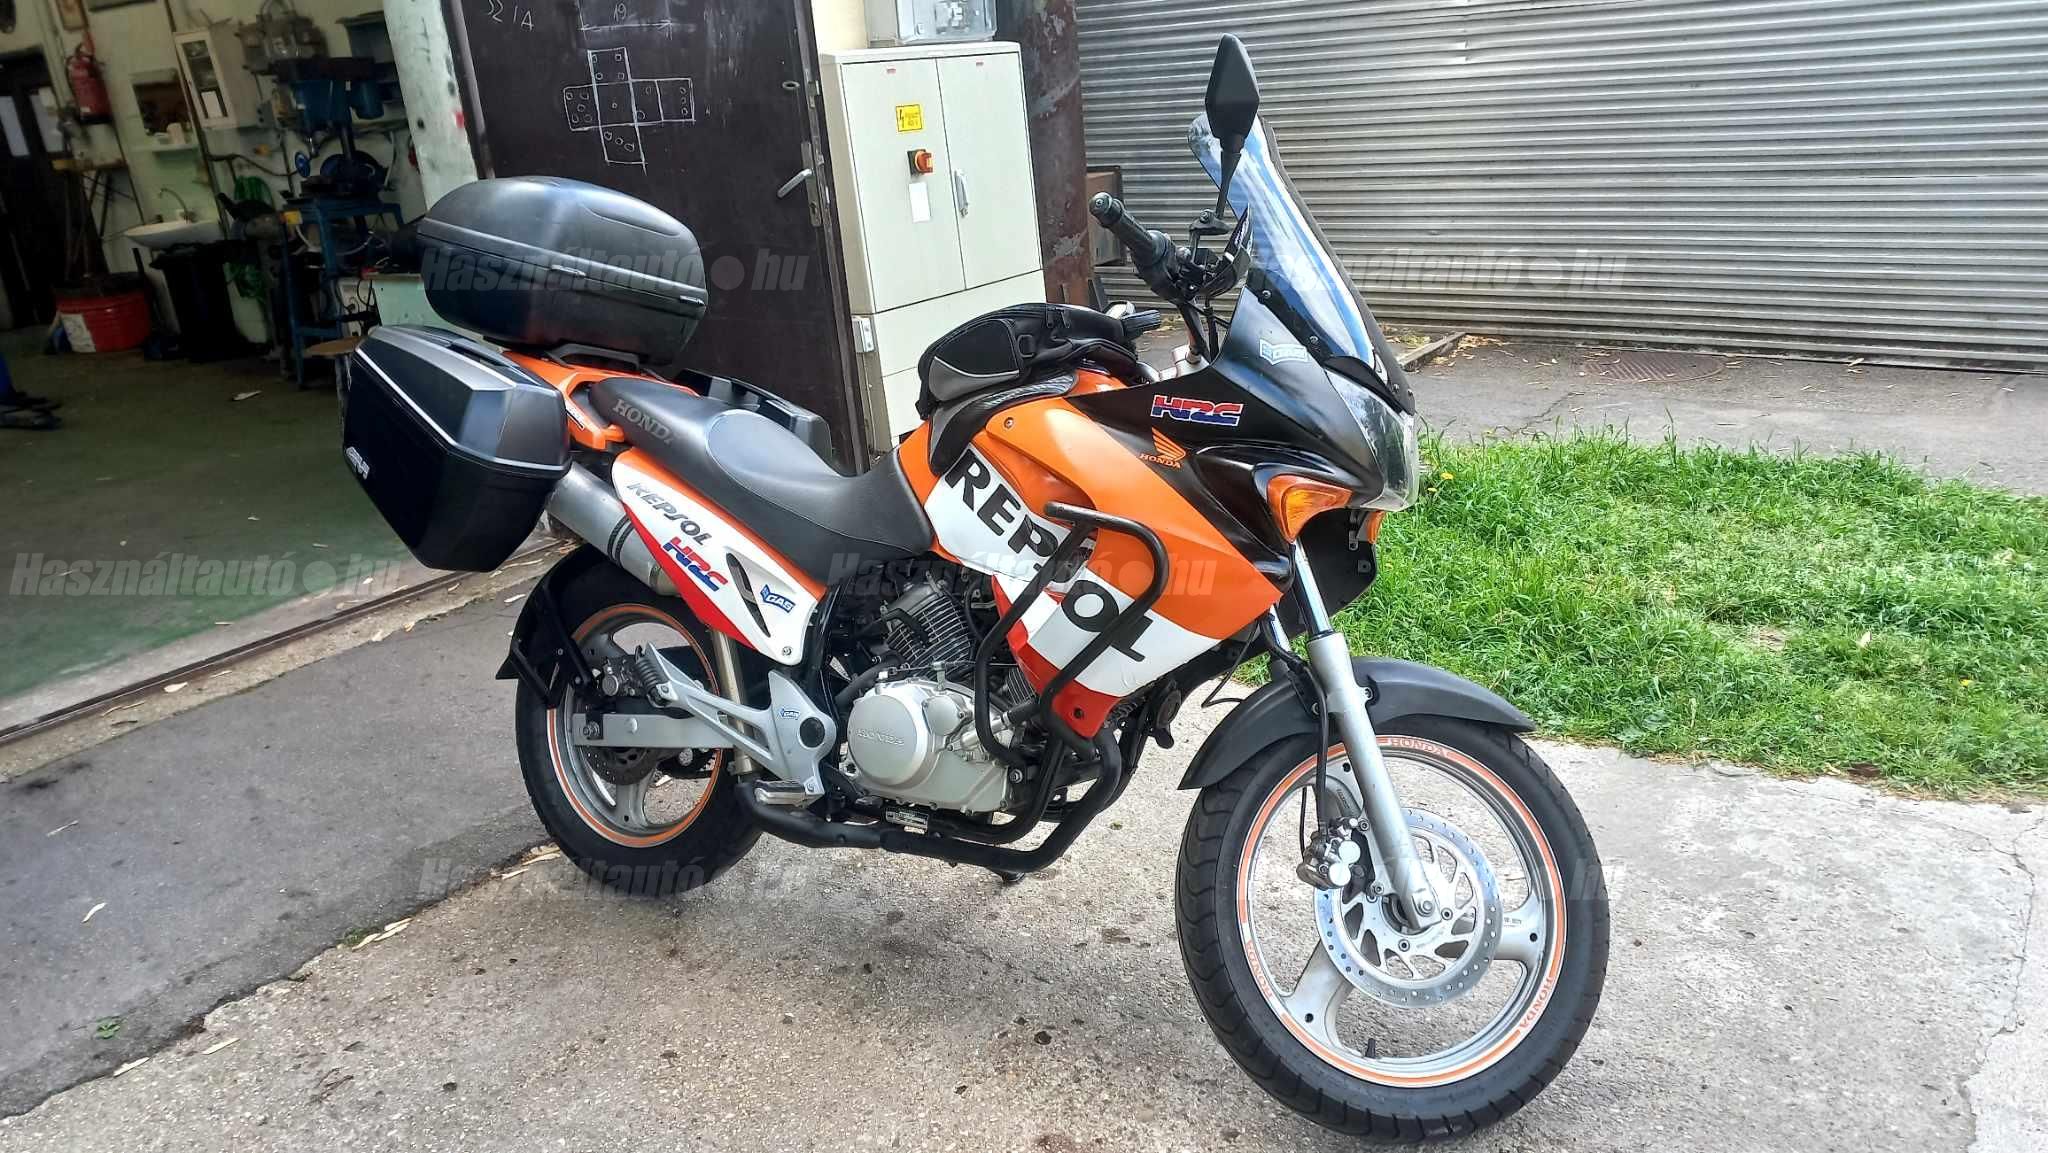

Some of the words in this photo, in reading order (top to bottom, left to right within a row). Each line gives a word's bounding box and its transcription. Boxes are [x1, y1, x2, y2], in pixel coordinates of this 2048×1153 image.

[1150, 394, 1244, 427] HRC
[1139, 453, 1182, 469] HONDA
[626, 482, 713, 546] REPSOL
[662, 536, 728, 592] HRC
[1391, 736, 1446, 756] HONDA
[1519, 976, 1556, 1029] HONDA
